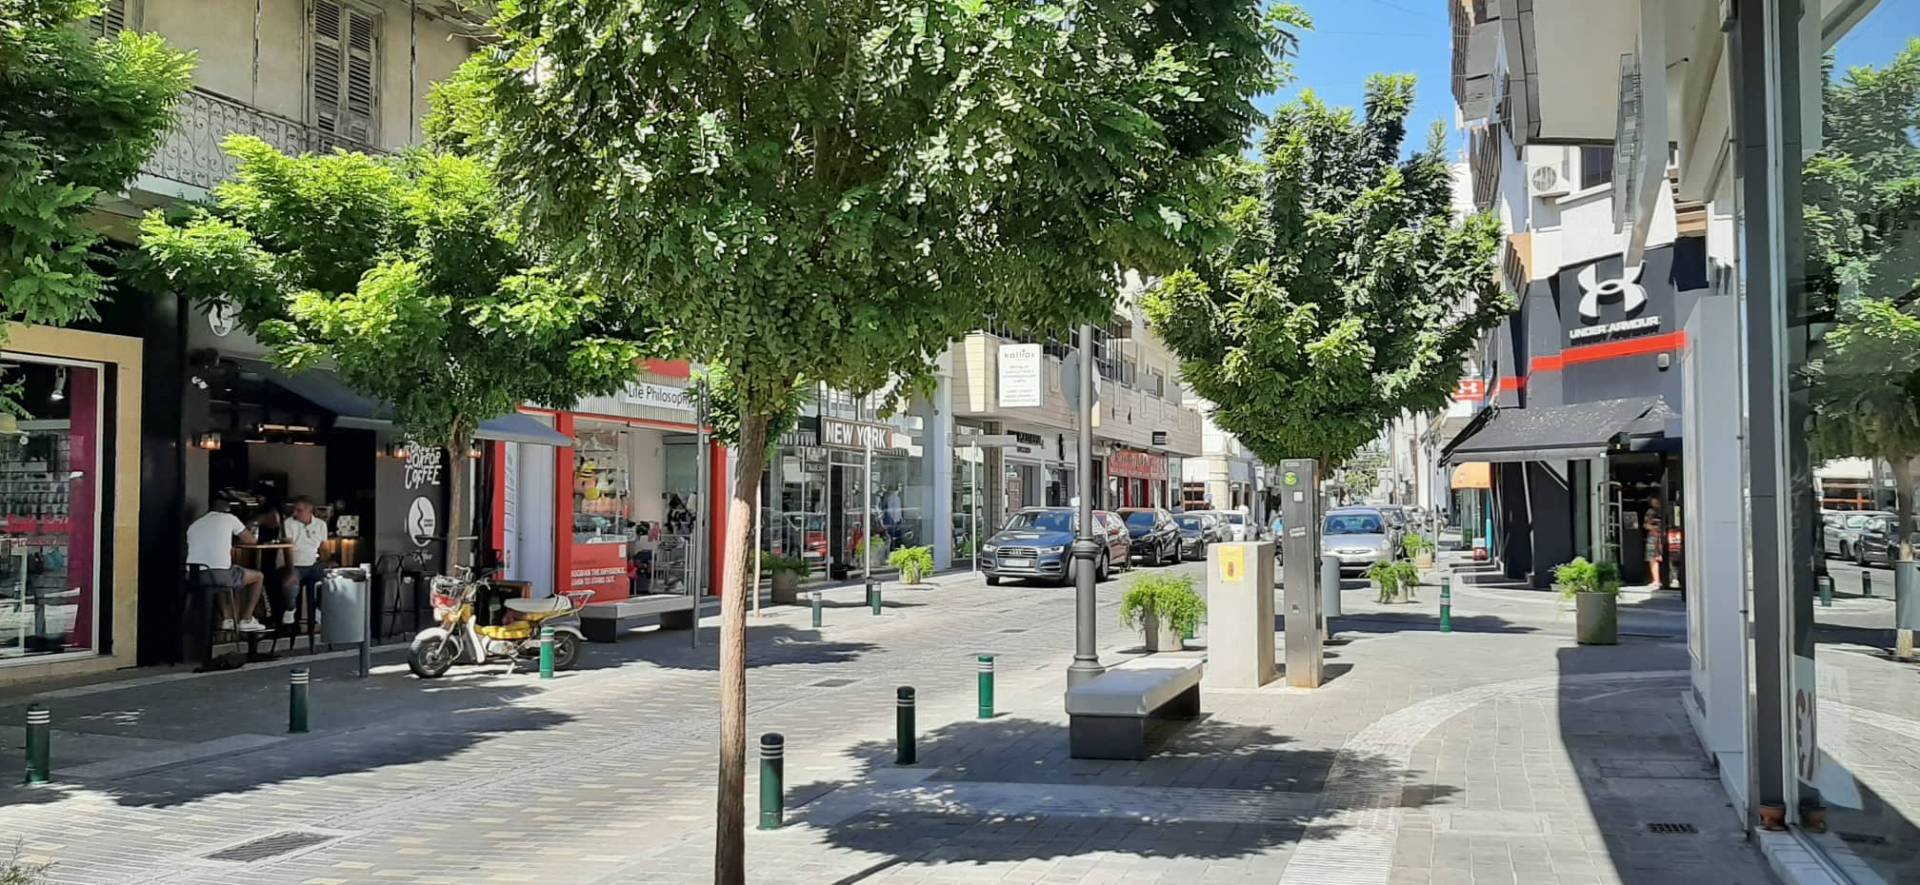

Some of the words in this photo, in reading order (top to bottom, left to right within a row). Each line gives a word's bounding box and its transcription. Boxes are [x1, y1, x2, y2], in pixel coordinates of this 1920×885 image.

[1569, 324, 1608, 339] UNDER
[1608, 316, 1660, 332] ARMOUR
[826, 421, 854, 445] NEW
[857, 424, 887, 449] YORK
[404, 464, 442, 490] COFFEE
